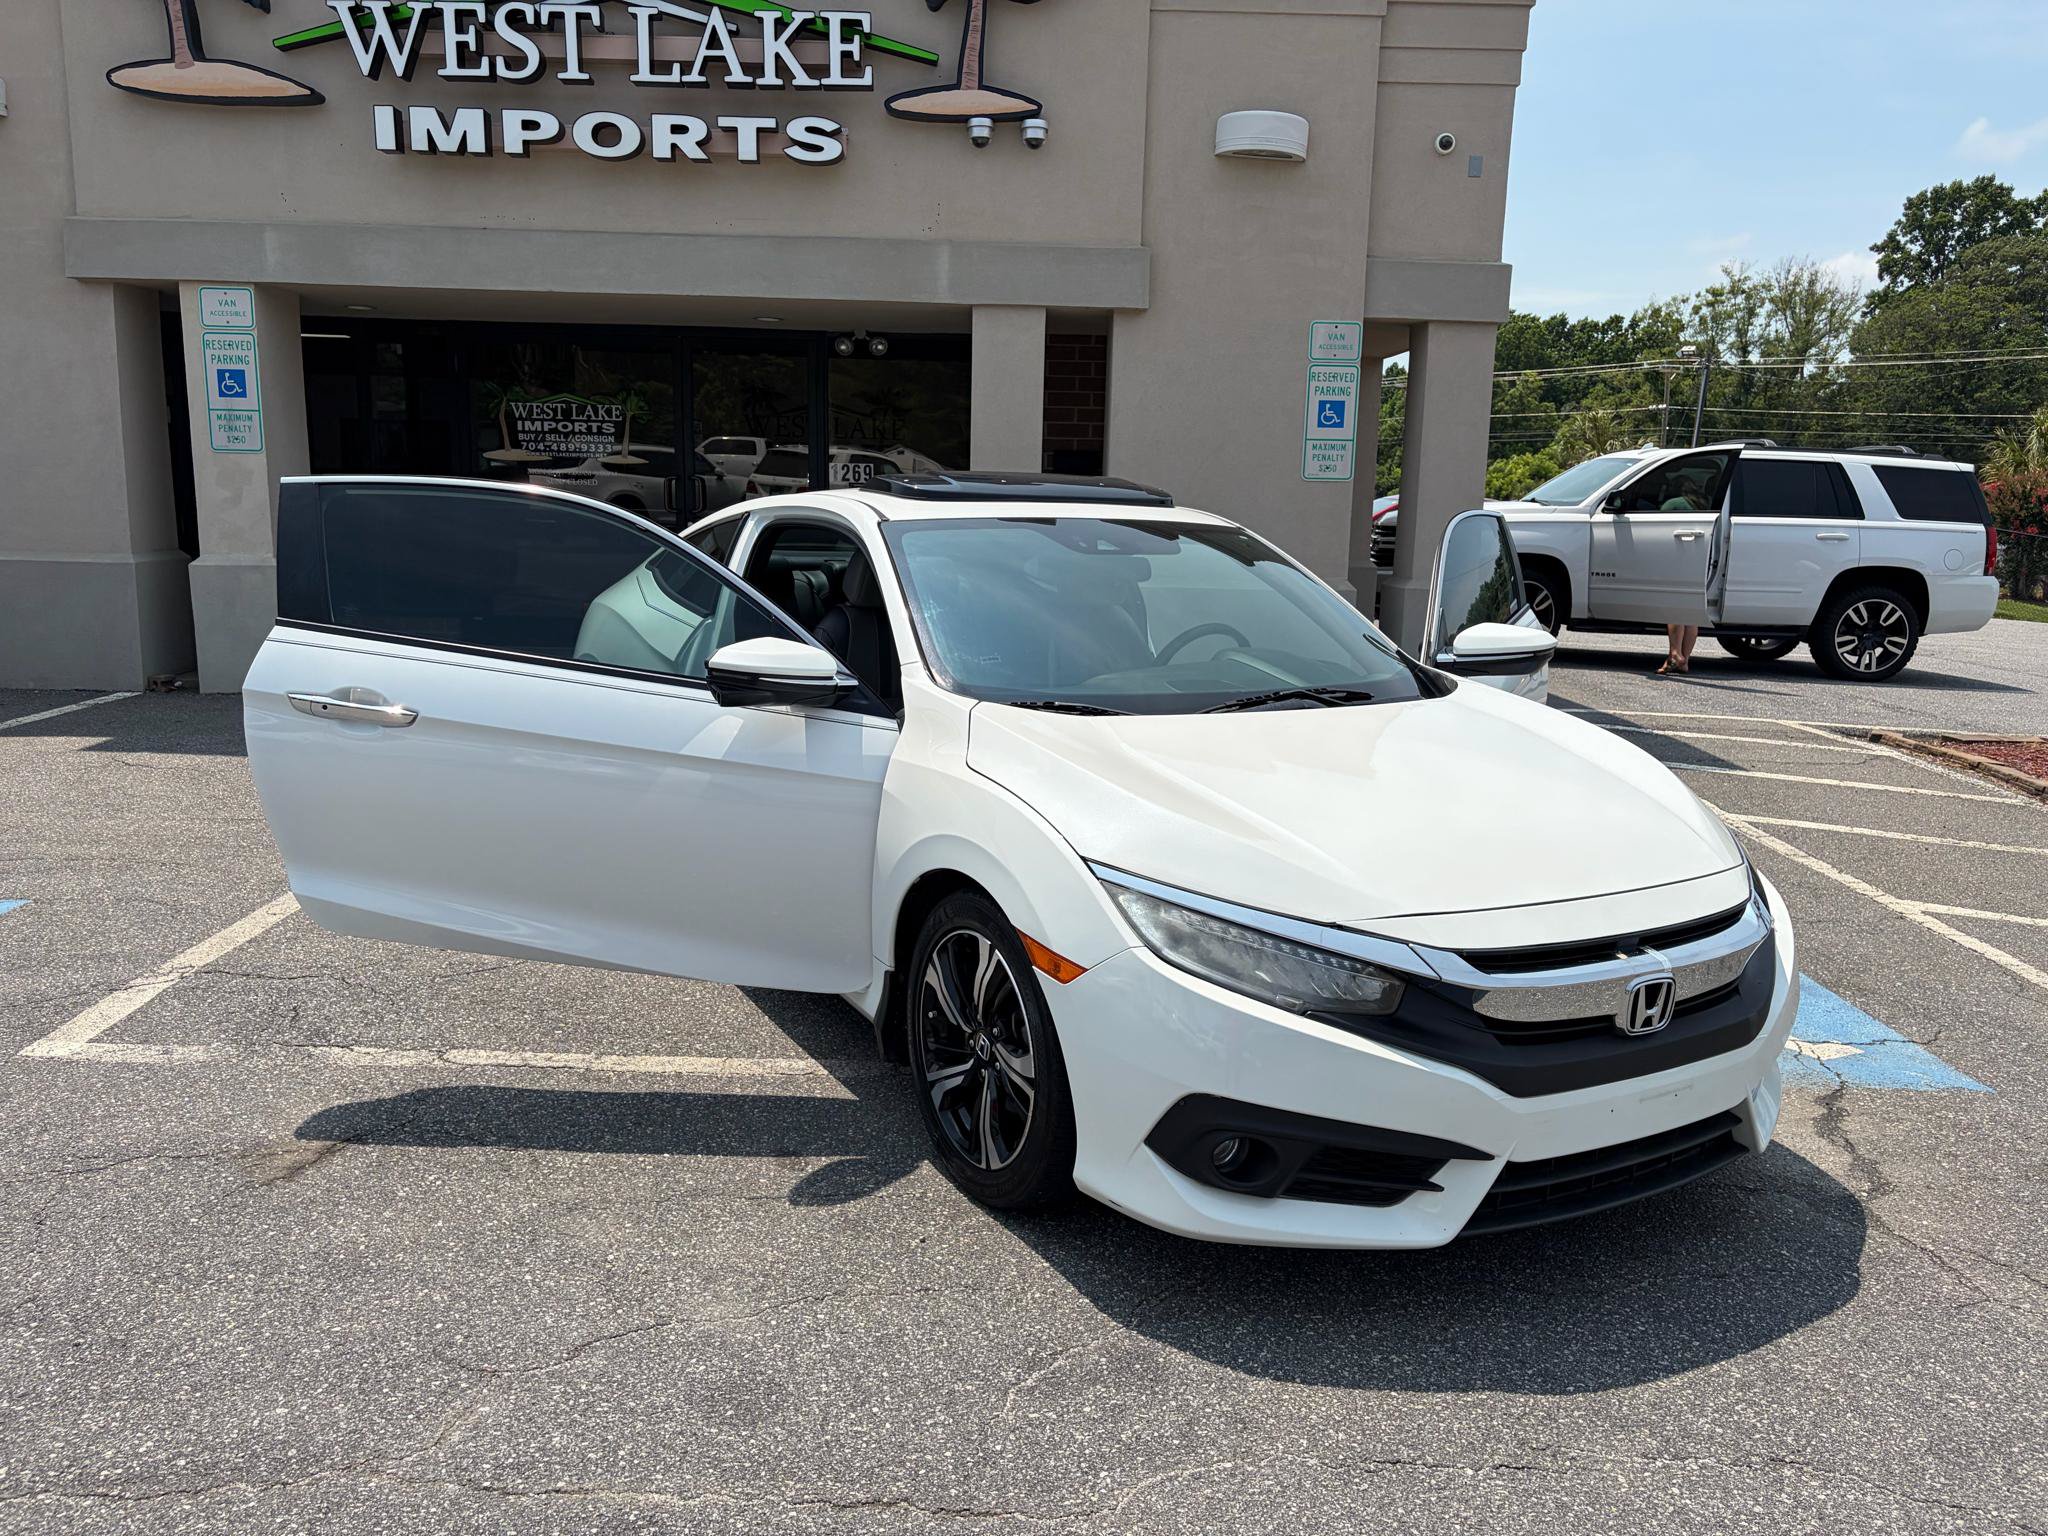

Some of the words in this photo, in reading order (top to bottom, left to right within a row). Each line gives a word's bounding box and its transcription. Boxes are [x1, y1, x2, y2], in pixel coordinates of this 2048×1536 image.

[326, 0, 601, 83] WEST
[627, 5, 874, 88] LAKE
[373, 104, 847, 165] IMPORTS
[218, 299, 237, 307] VAN
[1327, 333, 1346, 341] VAN
[205, 339, 252, 351] RESERVED
[1318, 343, 1353, 351] ACCESSIBLE
[210, 354, 250, 366] PARKING
[1311, 371, 1355, 383] RESERVED
[1314, 386, 1351, 397] PARKING
[509, 402, 567, 419] WEST
[571, 404, 623, 421] LAKE
[216, 413, 253, 423] MAXIMUM
[218, 424, 252, 433] PENALTY
[517, 420, 616, 434] IMPORTS
[575, 435, 615, 443] CONSIGN
[520, 442, 612, 453] 704.489.9333
[1311, 443, 1347, 451] MAXIMUM
[1312, 453, 1345, 462] PENALTY
